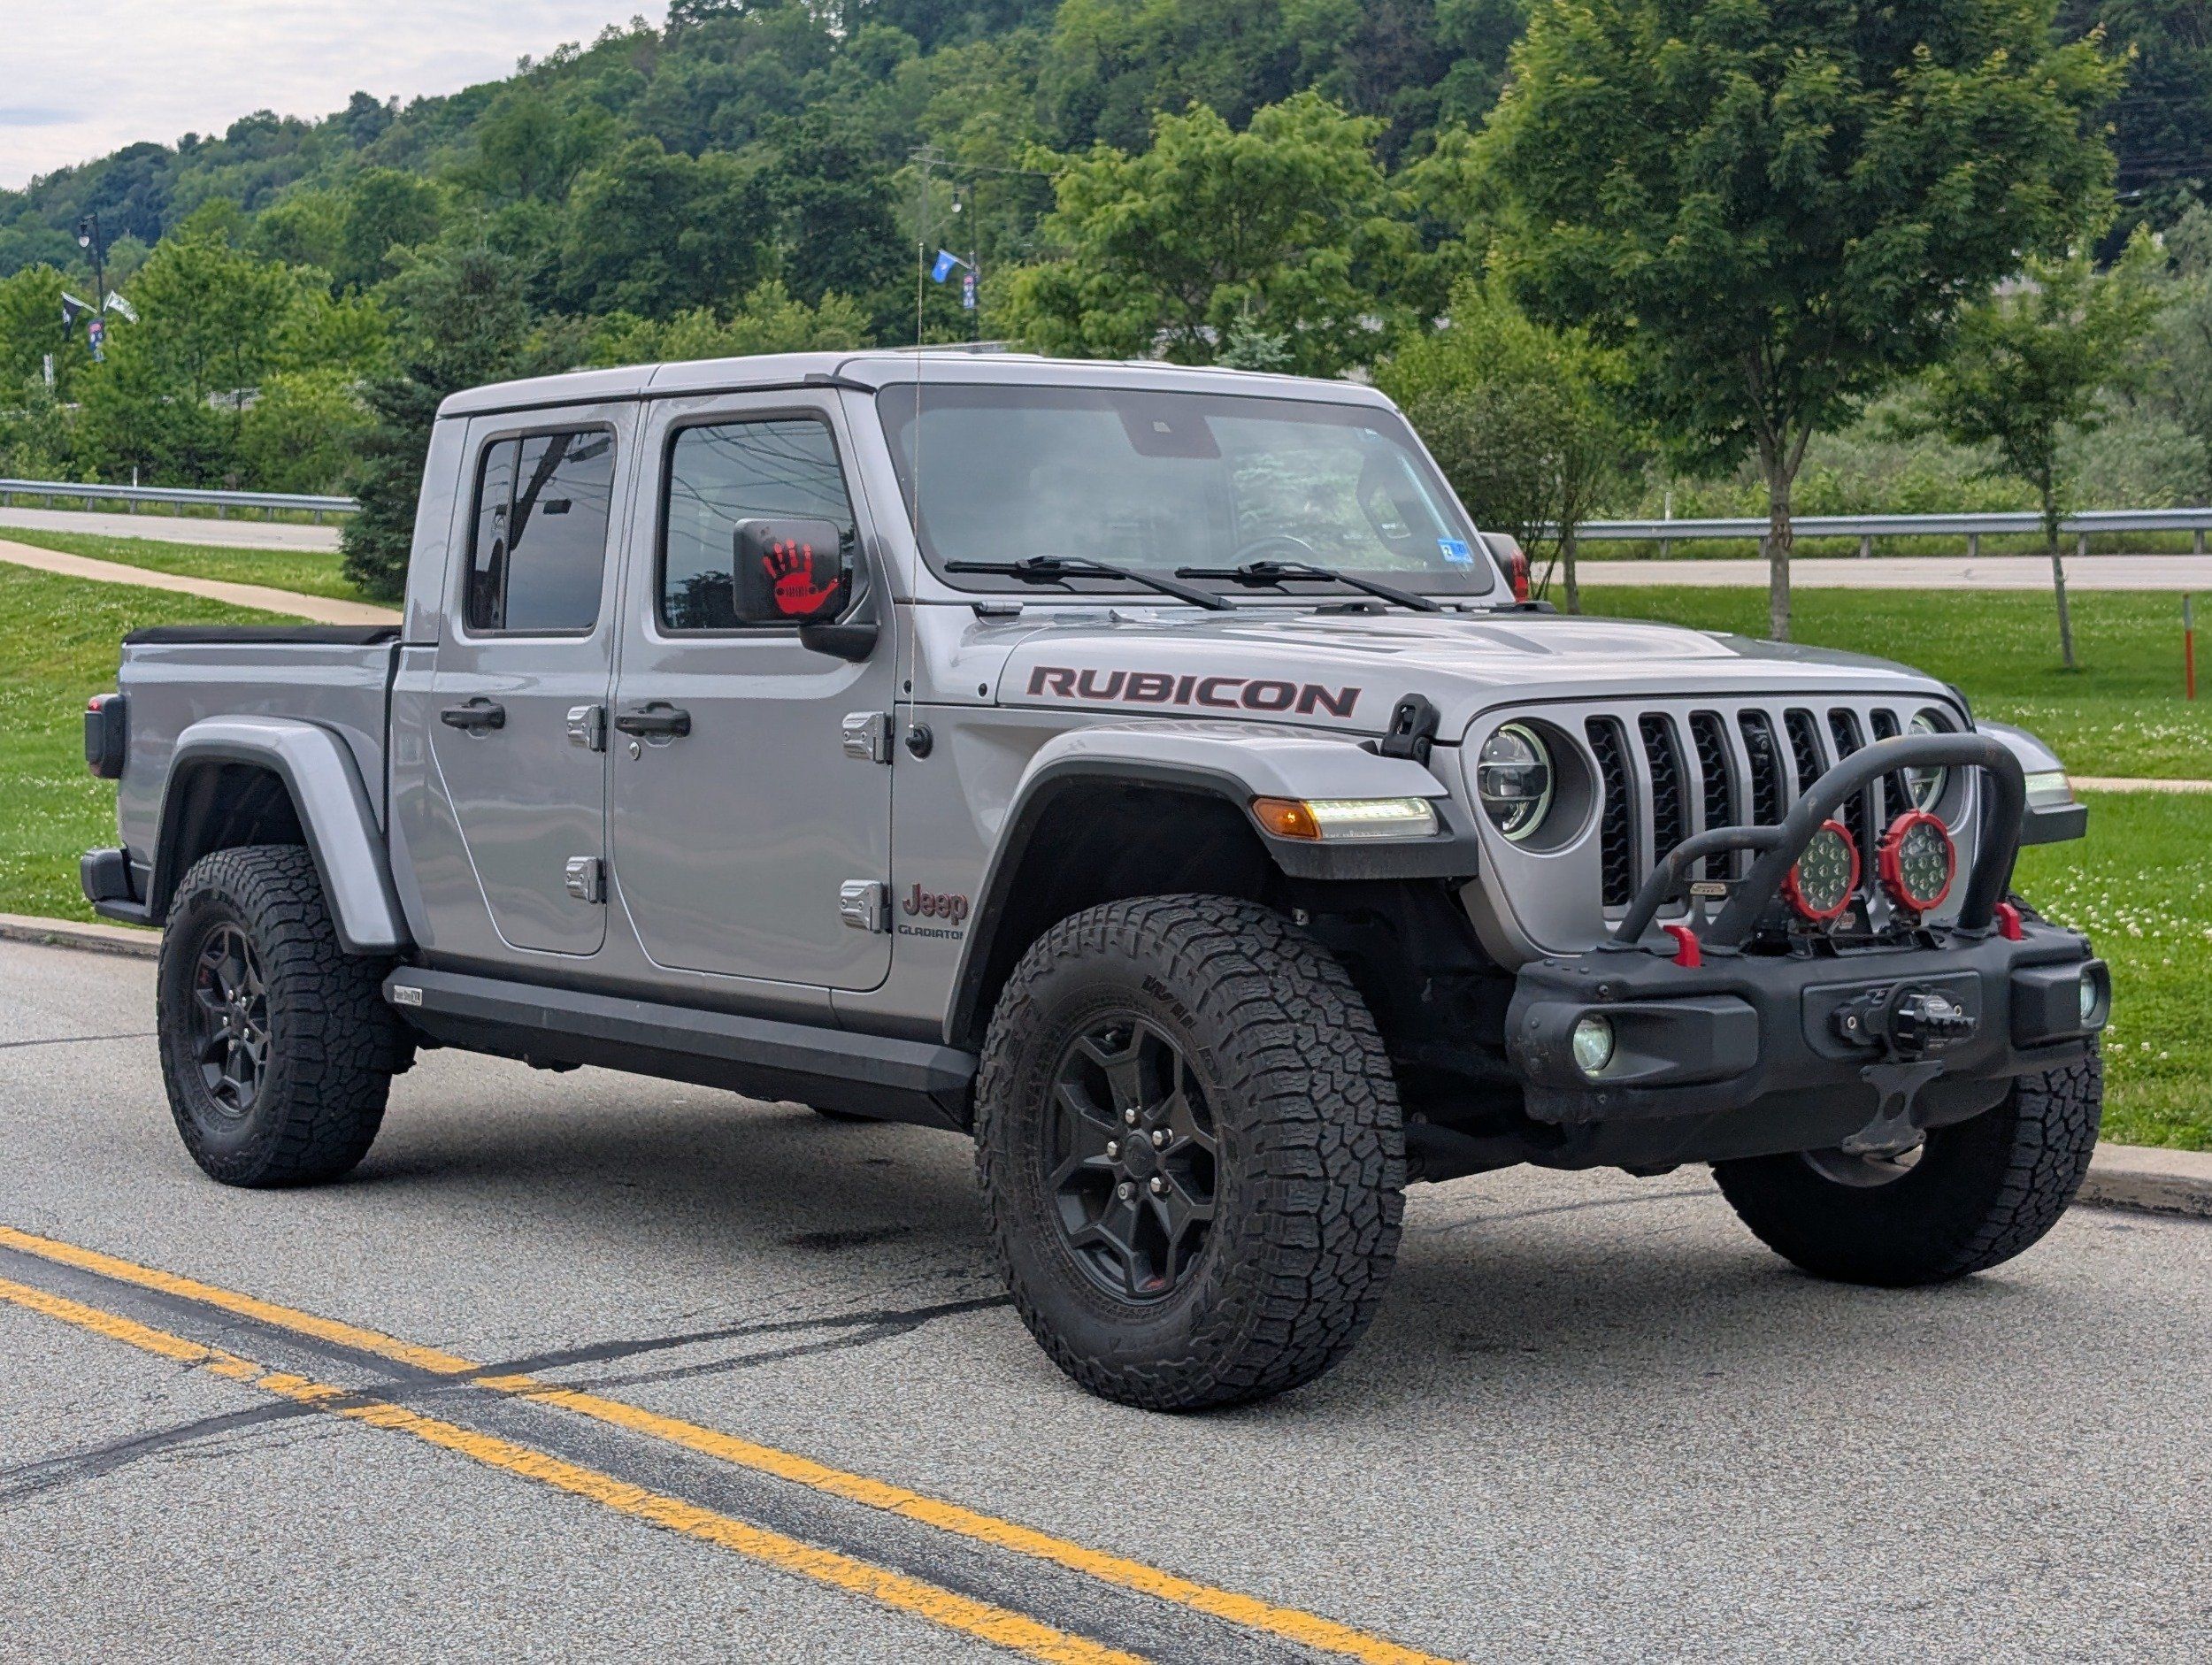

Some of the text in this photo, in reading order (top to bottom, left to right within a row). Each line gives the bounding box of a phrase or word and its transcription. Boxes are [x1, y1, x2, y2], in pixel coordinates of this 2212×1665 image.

[1025, 665, 1362, 718] RUBICON
[902, 883, 969, 926] Jeep
[897, 924, 964, 940] GLADIATOR
